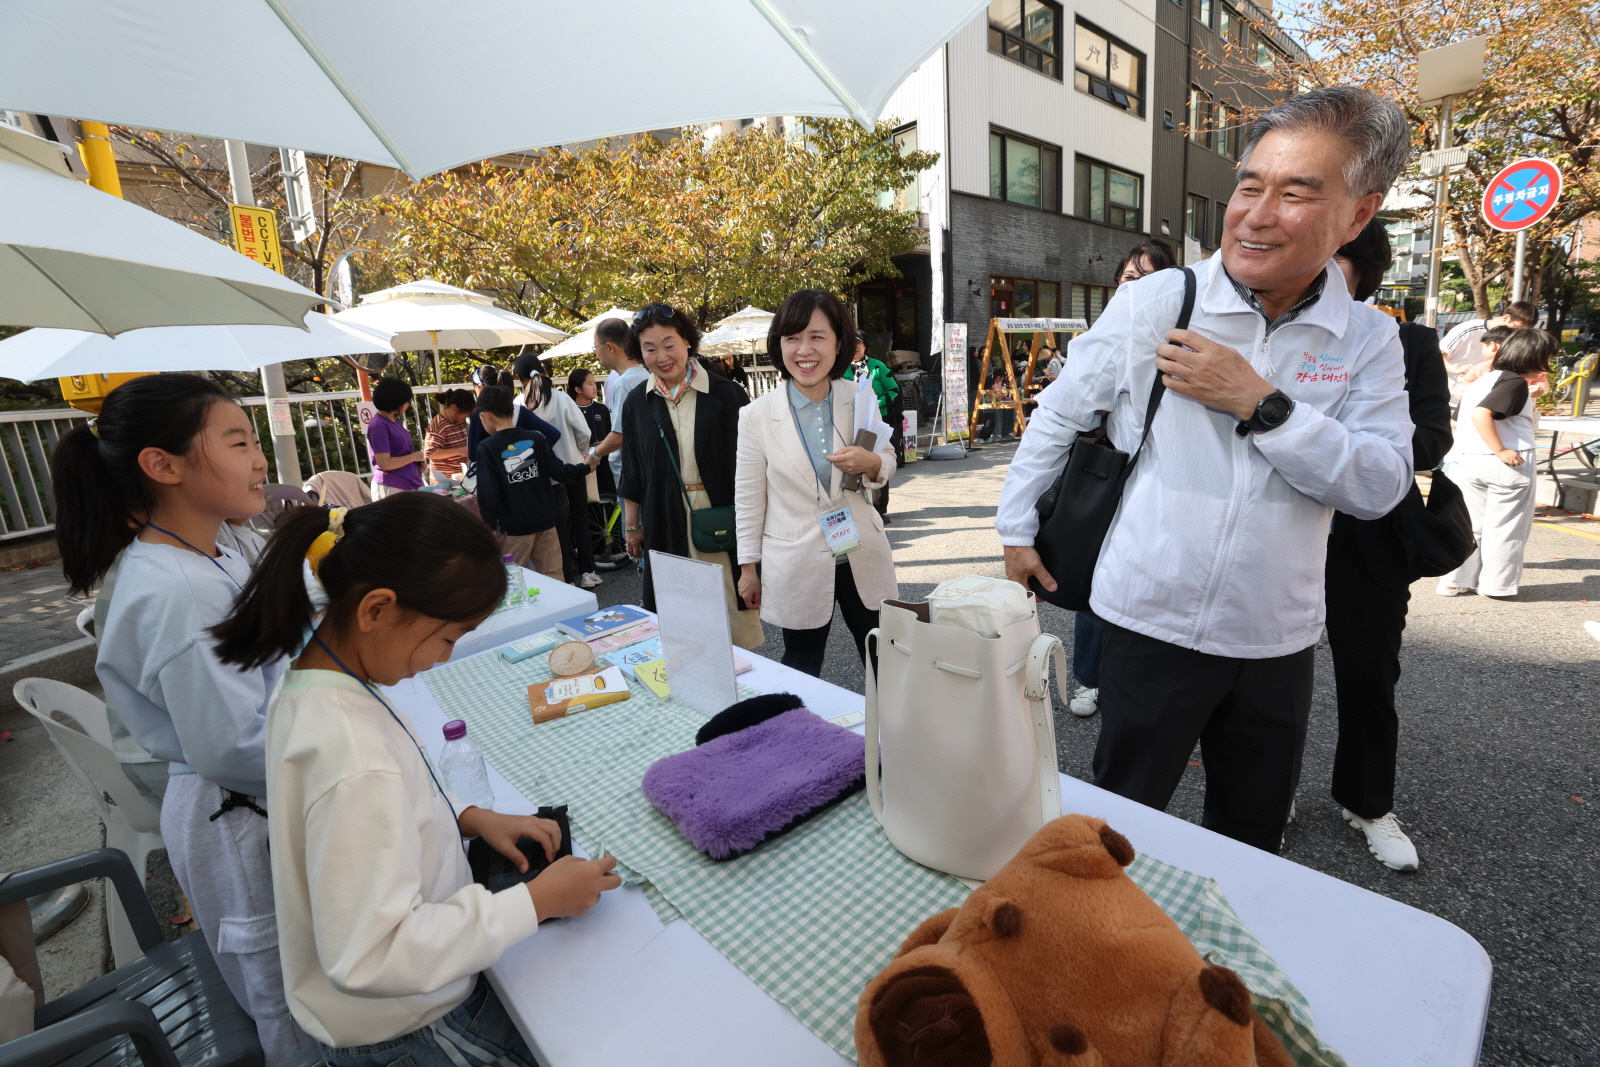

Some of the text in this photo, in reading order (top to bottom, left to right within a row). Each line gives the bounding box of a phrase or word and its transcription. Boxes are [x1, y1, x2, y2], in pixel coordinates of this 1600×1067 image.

[1493, 184, 1549, 206] 주정차금지
[239, 213, 256, 243] 불법
[1295, 372, 1319, 383] 강남
[831, 528, 850, 539] STAFF
